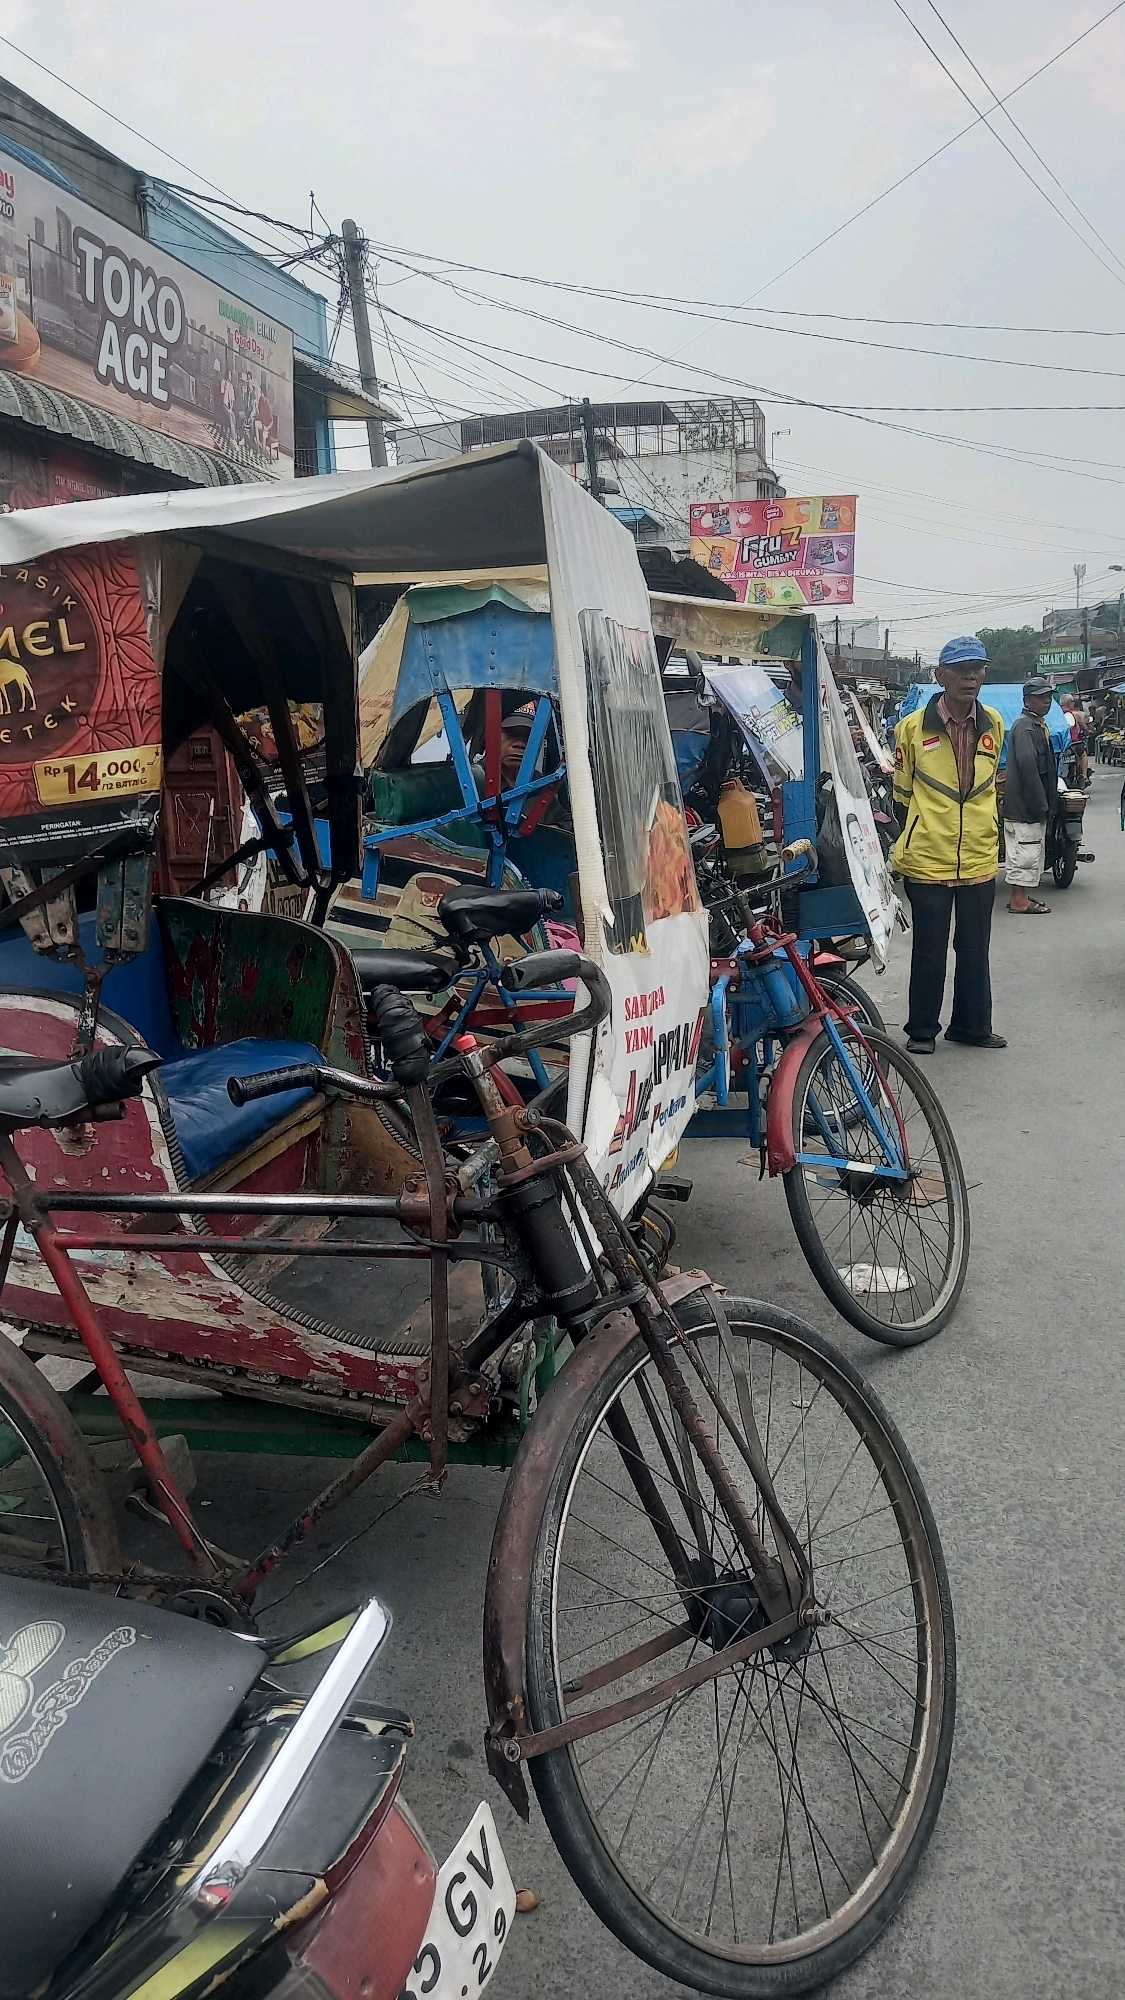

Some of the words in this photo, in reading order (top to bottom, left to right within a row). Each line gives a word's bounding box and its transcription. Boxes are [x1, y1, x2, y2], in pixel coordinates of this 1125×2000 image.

[78, 237, 182, 344] TOKO
[257, 320, 277, 344] BIKIN
[251, 338, 265, 361] Day
[98, 321, 169, 402] AGE
[753, 551, 798, 569] GUMMY
[767, 570, 786, 578] BISA
[787, 568, 824, 577] DIKUPAS!
[1039, 653, 1065, 665] SMART
[1067, 651, 1085, 664] SHO
[41, 820, 83, 831] PERINGATAN:
[445, 1825, 494, 1938] GV
